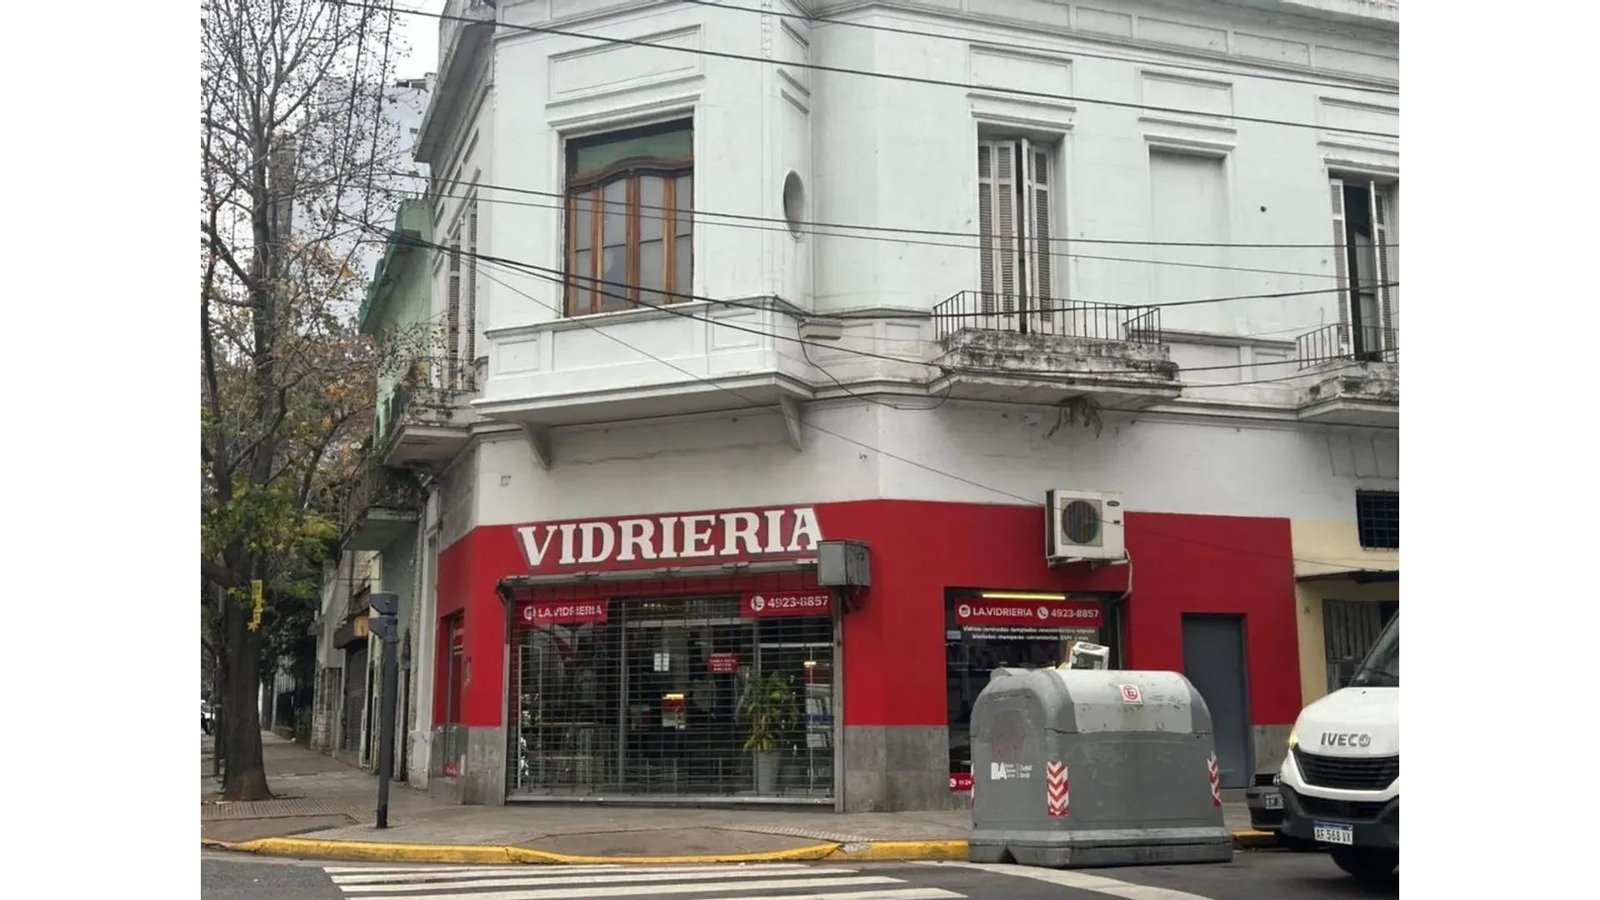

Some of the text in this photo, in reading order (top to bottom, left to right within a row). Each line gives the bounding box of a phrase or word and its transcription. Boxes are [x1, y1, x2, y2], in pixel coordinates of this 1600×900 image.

[518, 508, 822, 566] VIDRIERIA
[767, 595, 829, 608] 4923-8857
[973, 607, 1099, 618] LA.VIDRIERIA 4923-8857
[1320, 732, 1371, 747] IVECO
[991, 762, 1007, 780] BA
